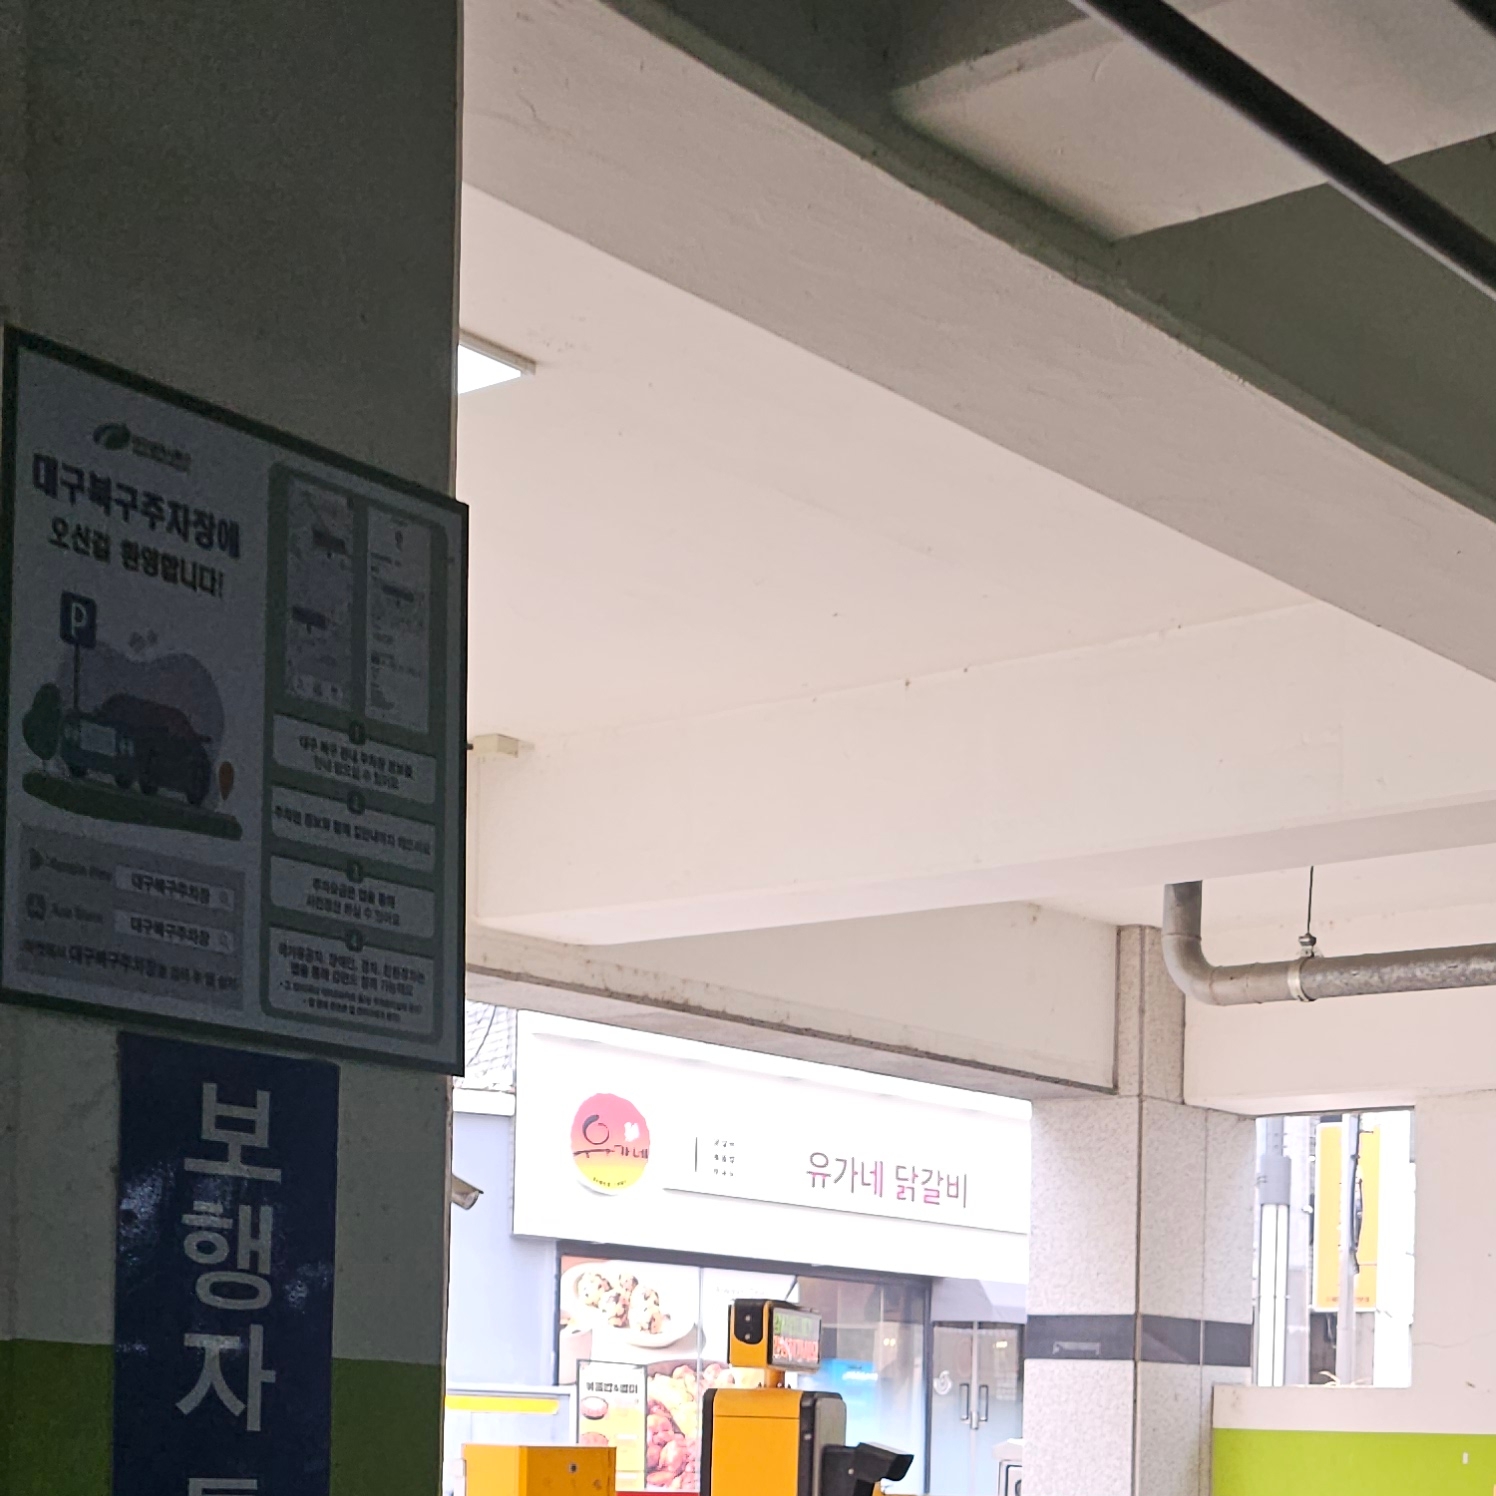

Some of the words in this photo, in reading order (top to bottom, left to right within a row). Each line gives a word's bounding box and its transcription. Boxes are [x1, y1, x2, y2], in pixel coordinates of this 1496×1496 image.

[174, 1082, 282, 1432] 보행자
[806, 1152, 883, 1198] 유가네
[896, 1165, 967, 1208] 닭갈비
